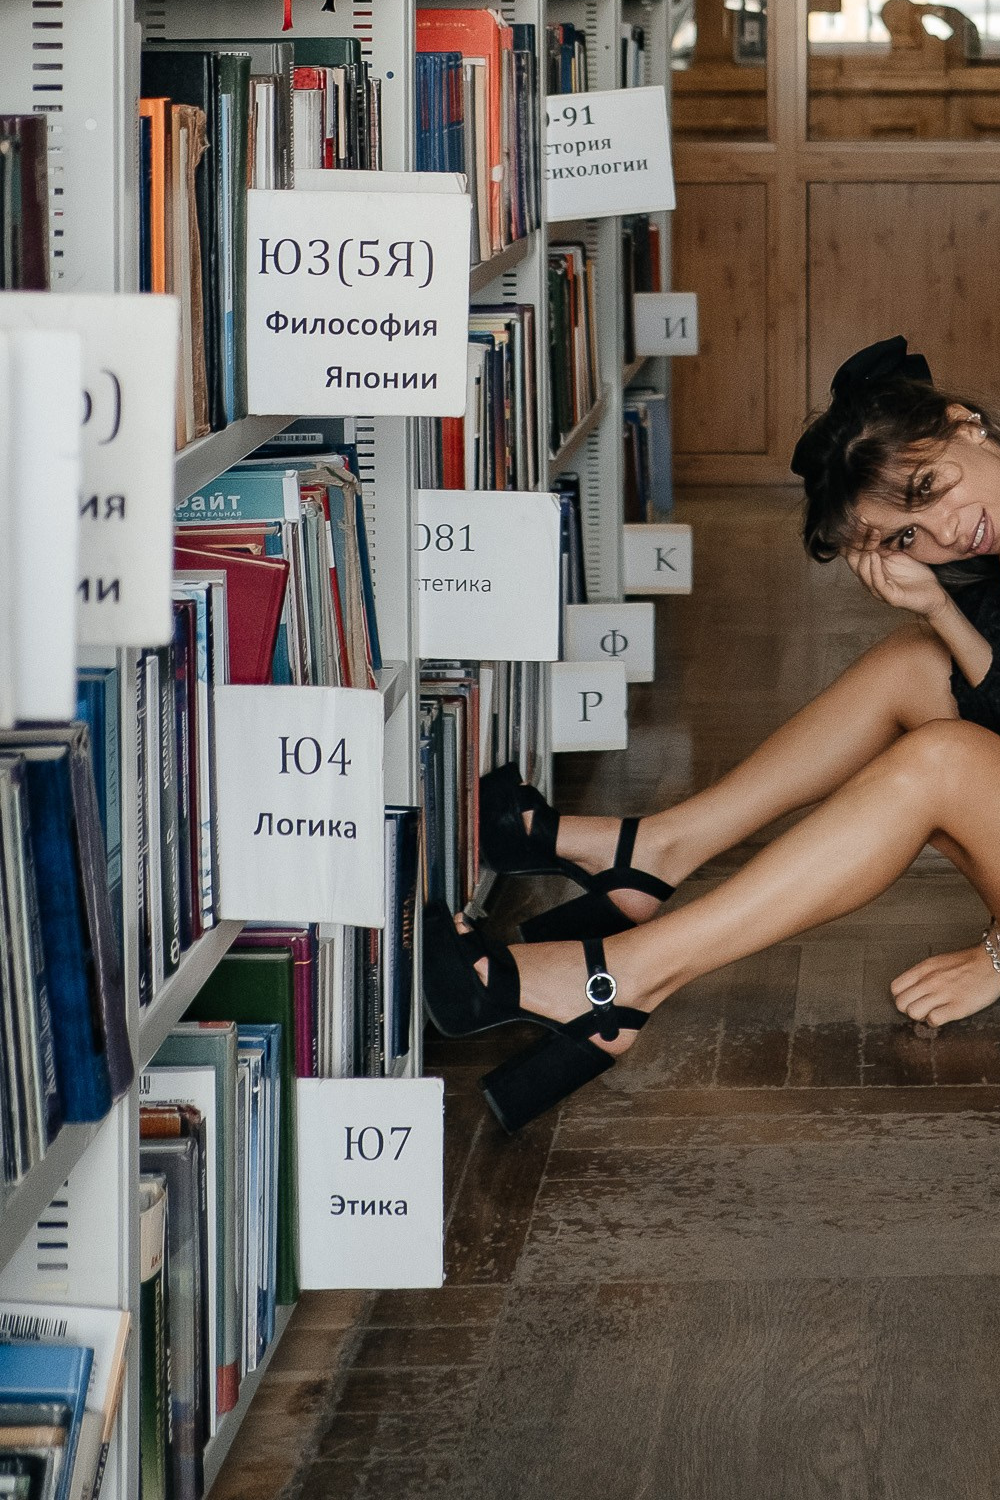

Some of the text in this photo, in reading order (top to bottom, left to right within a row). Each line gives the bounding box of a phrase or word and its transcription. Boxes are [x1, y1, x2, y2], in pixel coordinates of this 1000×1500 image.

[546, 138, 612, 158] стория
[547, 159, 649, 182] сихологии
[266, 311, 436, 341] Философия
[665, 317, 693, 340] И
[326, 366, 436, 389] Японии
[653, 546, 678, 572] К
[418, 578, 493, 593] тетика
[600, 630, 628, 656] Ф
[580, 692, 602, 721] Р
[280, 737, 351, 775] Ю4
[254, 813, 356, 839] Логика
[345, 1127, 411, 1160] Ю7
[331, 1195, 407, 1215] Этика
